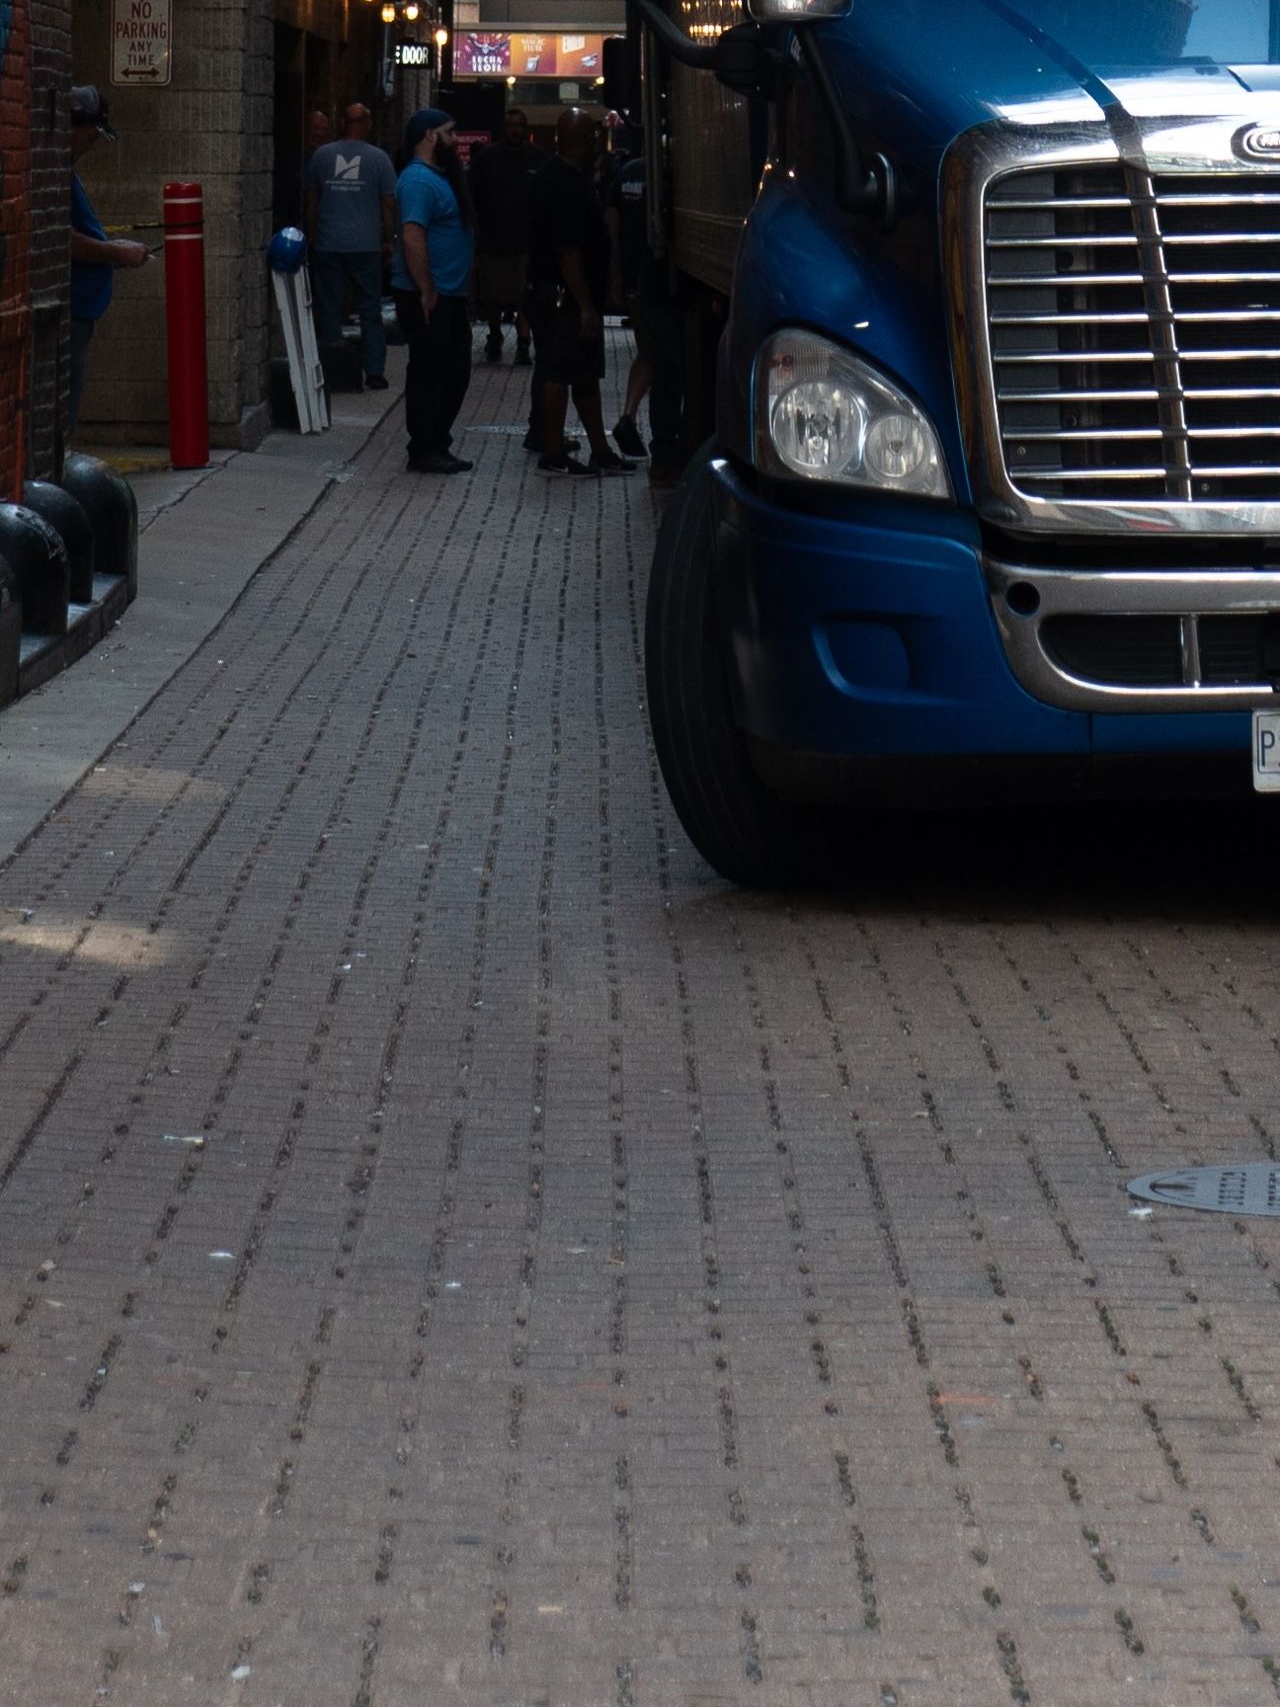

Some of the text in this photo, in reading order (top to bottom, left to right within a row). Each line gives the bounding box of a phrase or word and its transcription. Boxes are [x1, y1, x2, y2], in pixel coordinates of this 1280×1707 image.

[130, 2, 152, 19] NO
[115, 21, 167, 39] PARKING
[129, 41, 153, 53] ANY
[402, 45, 429, 65] DOOR
[127, 54, 155, 66] TIME
